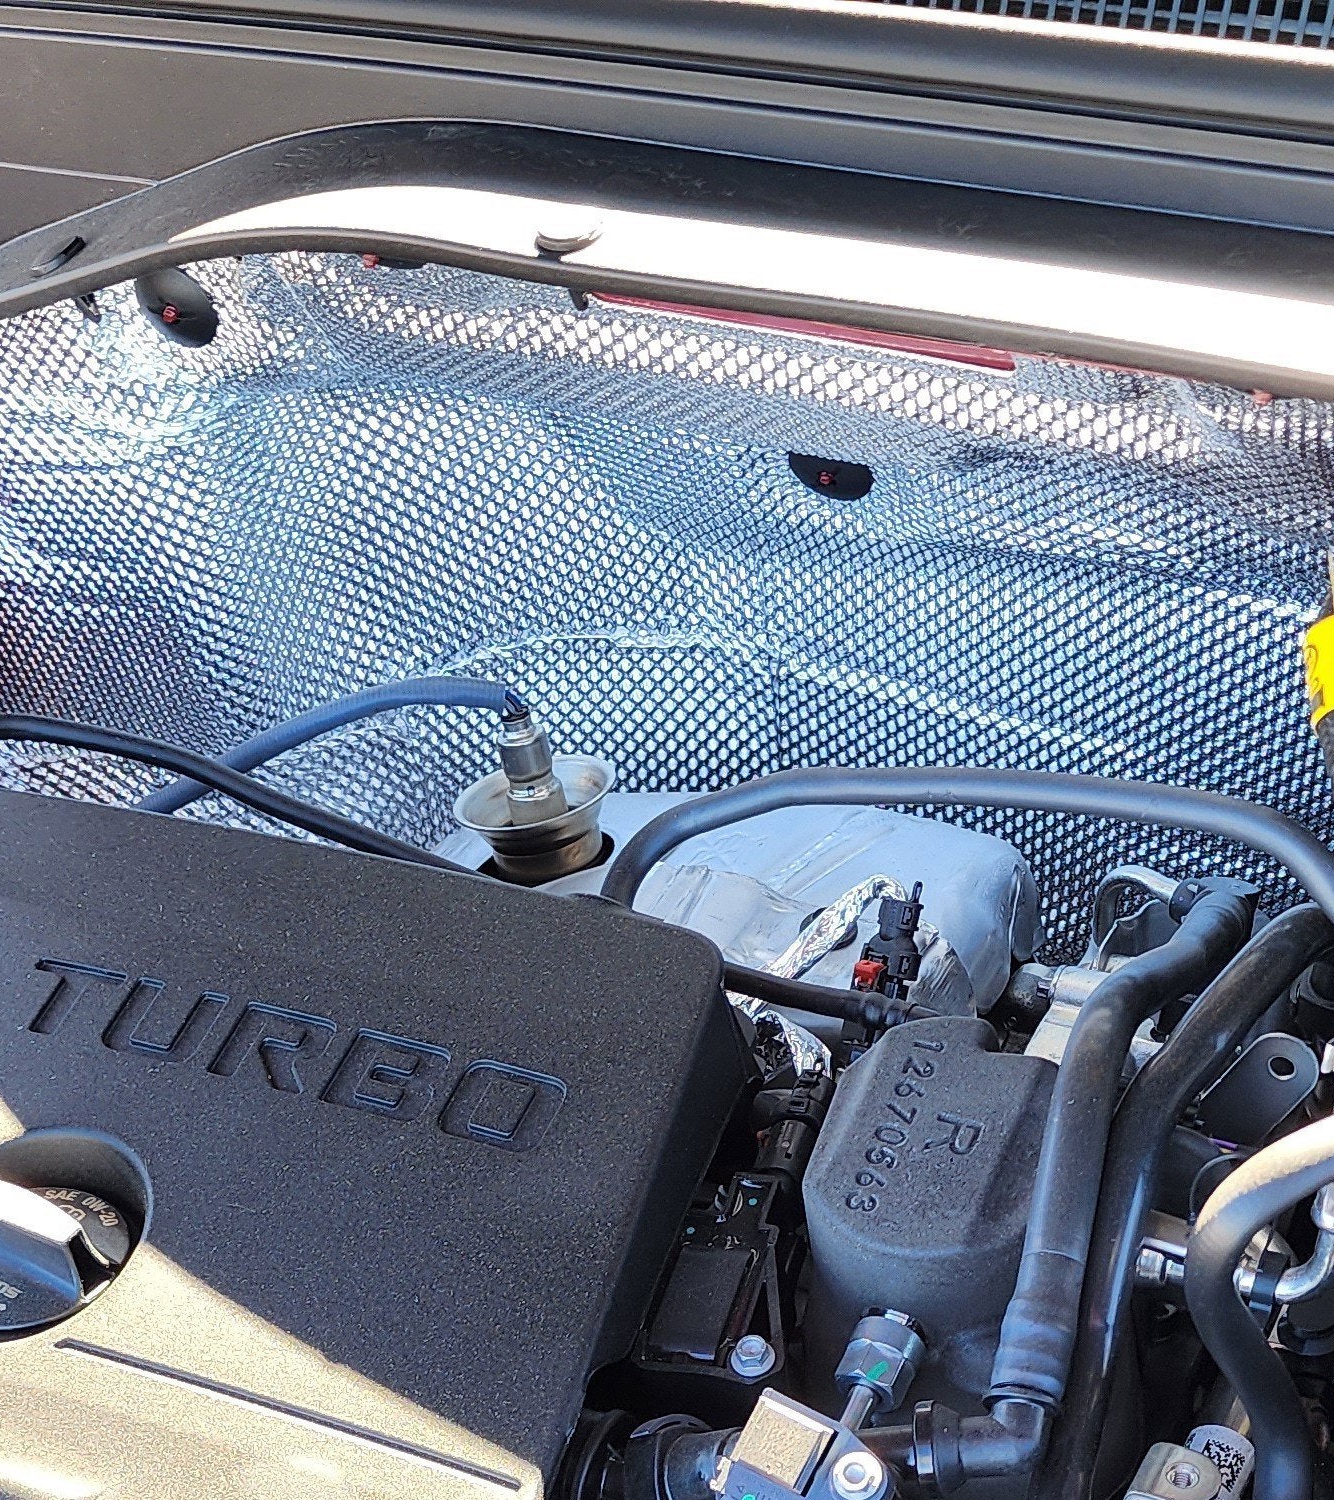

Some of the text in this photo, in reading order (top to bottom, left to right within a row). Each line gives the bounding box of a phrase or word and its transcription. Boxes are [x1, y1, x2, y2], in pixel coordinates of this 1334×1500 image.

[28, 957, 569, 1152] TURBO
[845, 1041, 945, 1212] 12670563
[923, 1111, 986, 1154] R
[44, 1189, 118, 1227] SAE 0W-20
